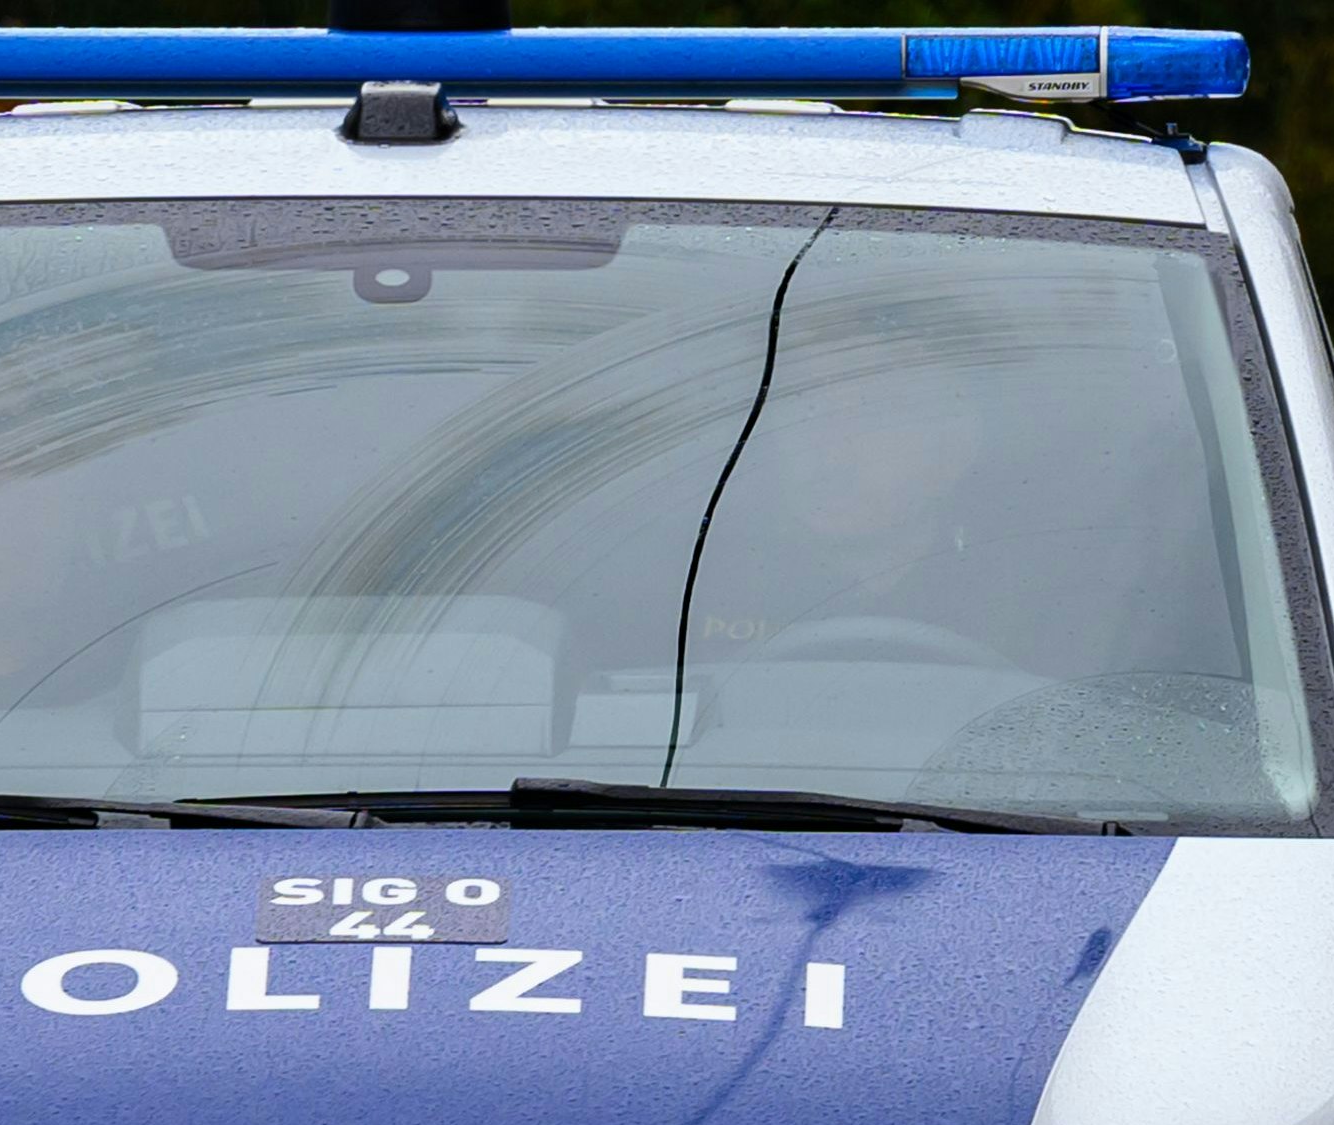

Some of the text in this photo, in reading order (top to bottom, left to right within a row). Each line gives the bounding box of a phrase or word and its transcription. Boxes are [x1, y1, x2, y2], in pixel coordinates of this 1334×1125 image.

[1027, 81, 1090, 91] STANDBY
[269, 877, 417, 906] SIG
[329, 911, 435, 940] 44
